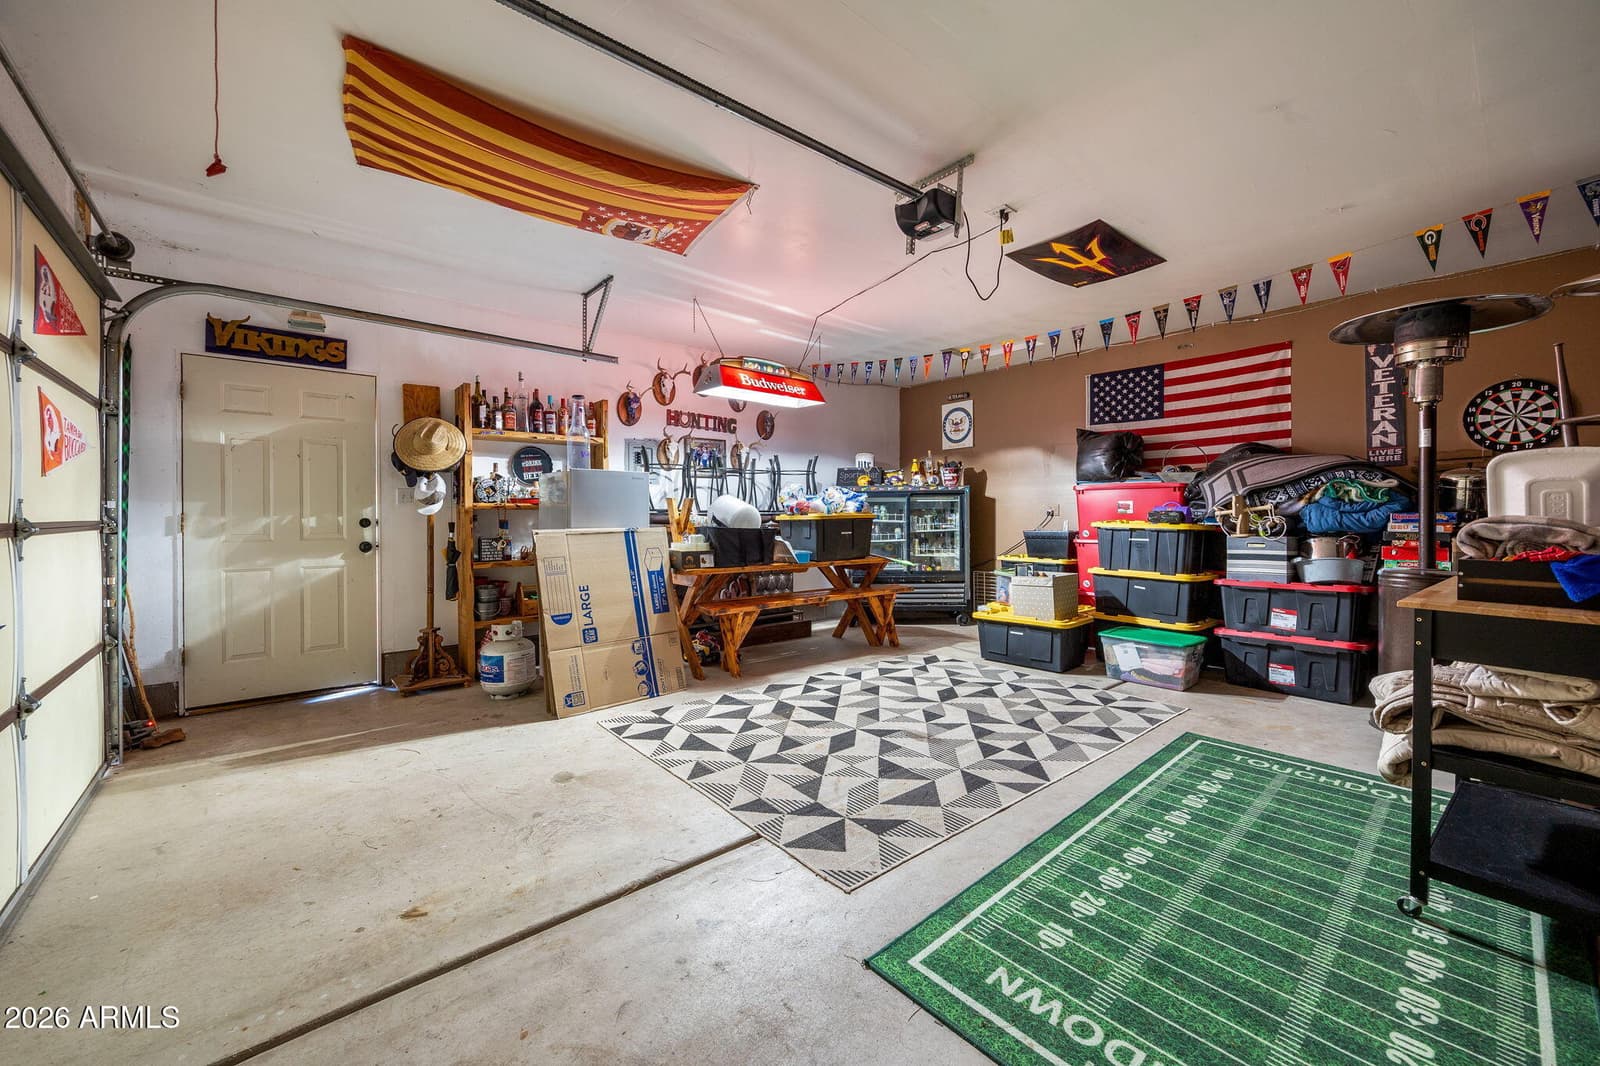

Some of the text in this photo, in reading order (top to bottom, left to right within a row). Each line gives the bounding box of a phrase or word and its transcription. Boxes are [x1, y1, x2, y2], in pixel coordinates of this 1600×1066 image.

[738, 373, 806, 395] Budweiser
[1370, 353, 1398, 448] VETERAN
[666, 408, 737, 434] HUNTING
[1368, 448, 1402, 456] LIVES
[578, 585, 594, 626] LARGE
[1197, 780, 1223, 793] 20
[1182, 794, 1209, 808] 30
[1164, 809, 1192, 825] 40
[1145, 827, 1175, 844] 50
[1123, 846, 1154, 865] 40
[1098, 866, 1133, 889] 30
[1070, 890, 1106, 917] 20
[1038, 921, 1073, 949] 10
[1404, 949, 1446, 983] 40
[985, 966, 1164, 1066] DOWN
[1396, 986, 1441, 1025] 30
